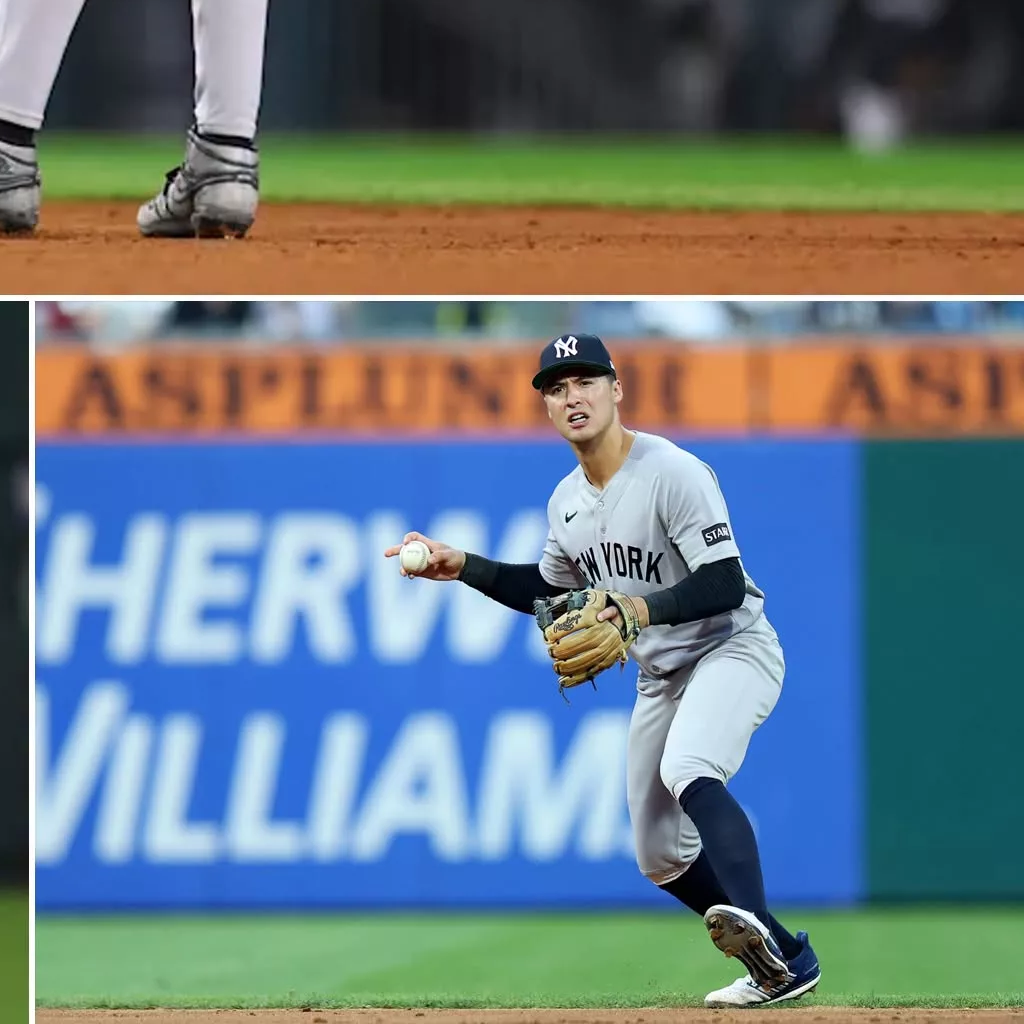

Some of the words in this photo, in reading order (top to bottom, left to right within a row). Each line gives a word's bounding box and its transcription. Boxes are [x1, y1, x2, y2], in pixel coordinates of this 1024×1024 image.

[554, 336, 578, 358] NY
[575, 546, 602, 589] EW
[600, 542, 664, 585] YORK
[35, 680, 642, 864] ILLIAM
